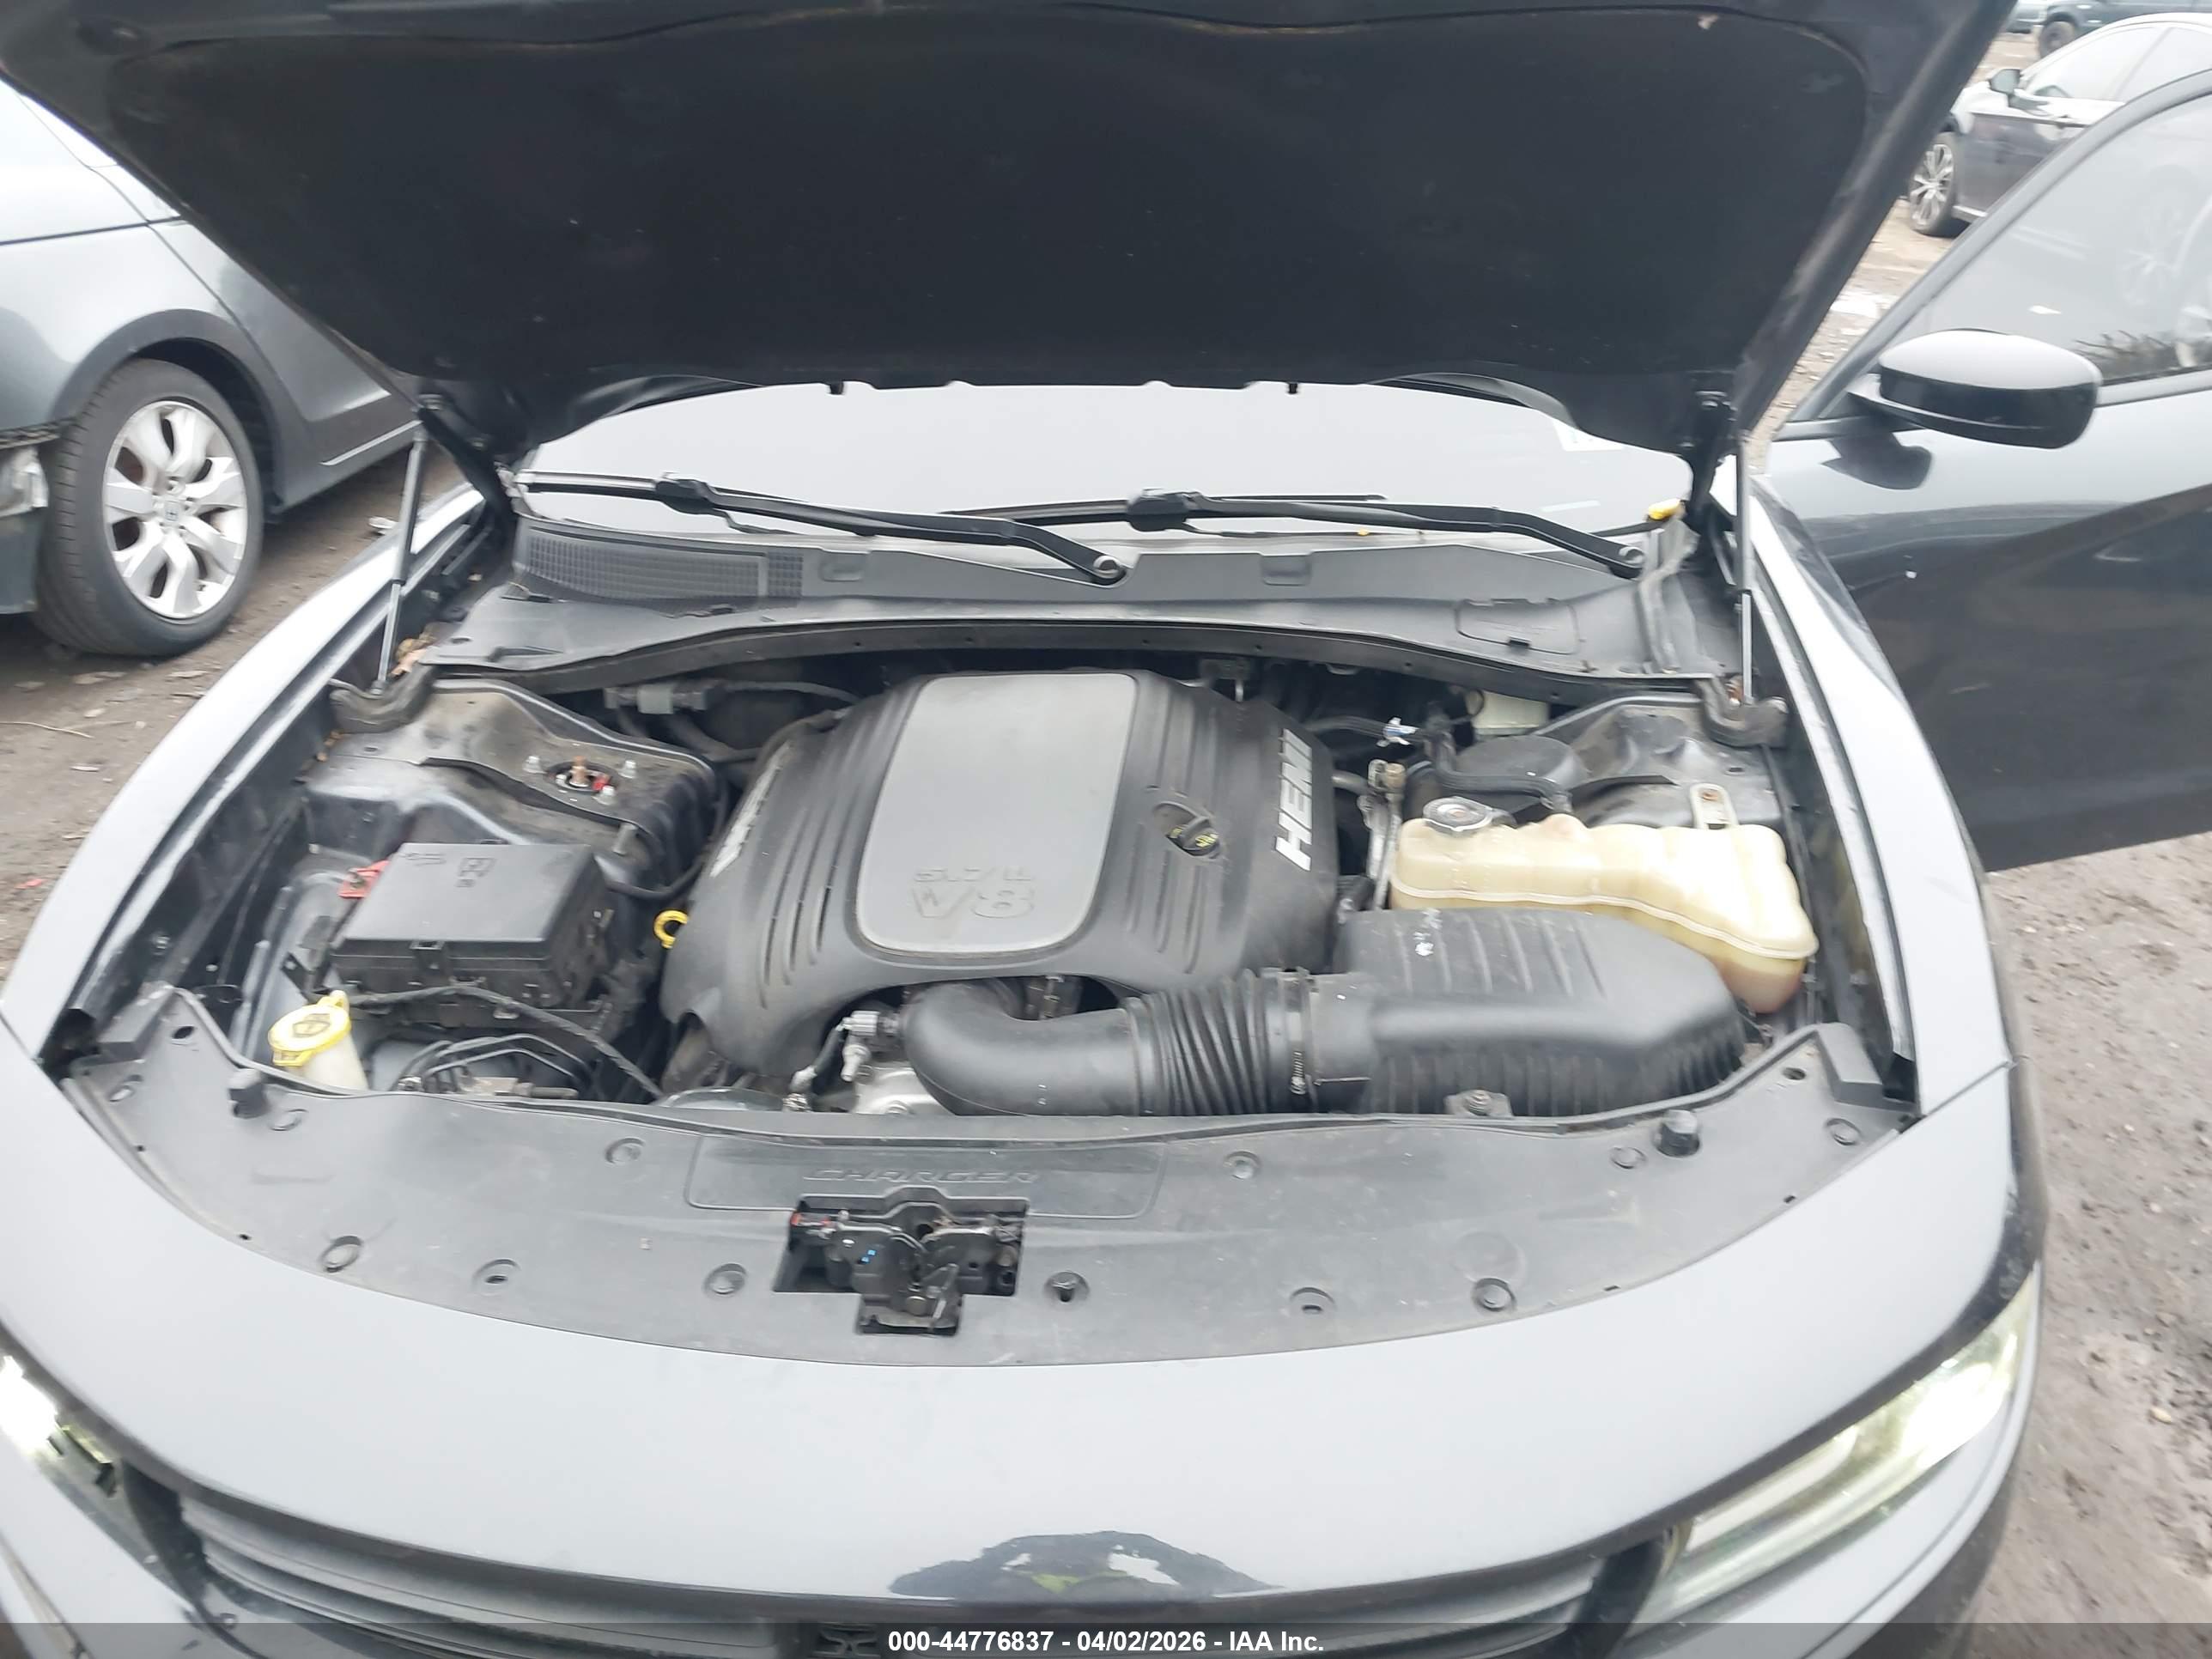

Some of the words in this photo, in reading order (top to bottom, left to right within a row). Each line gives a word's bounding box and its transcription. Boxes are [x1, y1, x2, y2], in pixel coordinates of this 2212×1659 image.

[1275, 728, 1313, 871] HEMI
[911, 884, 1035, 920] V8
[803, 1169, 1038, 1184] CHARGER
